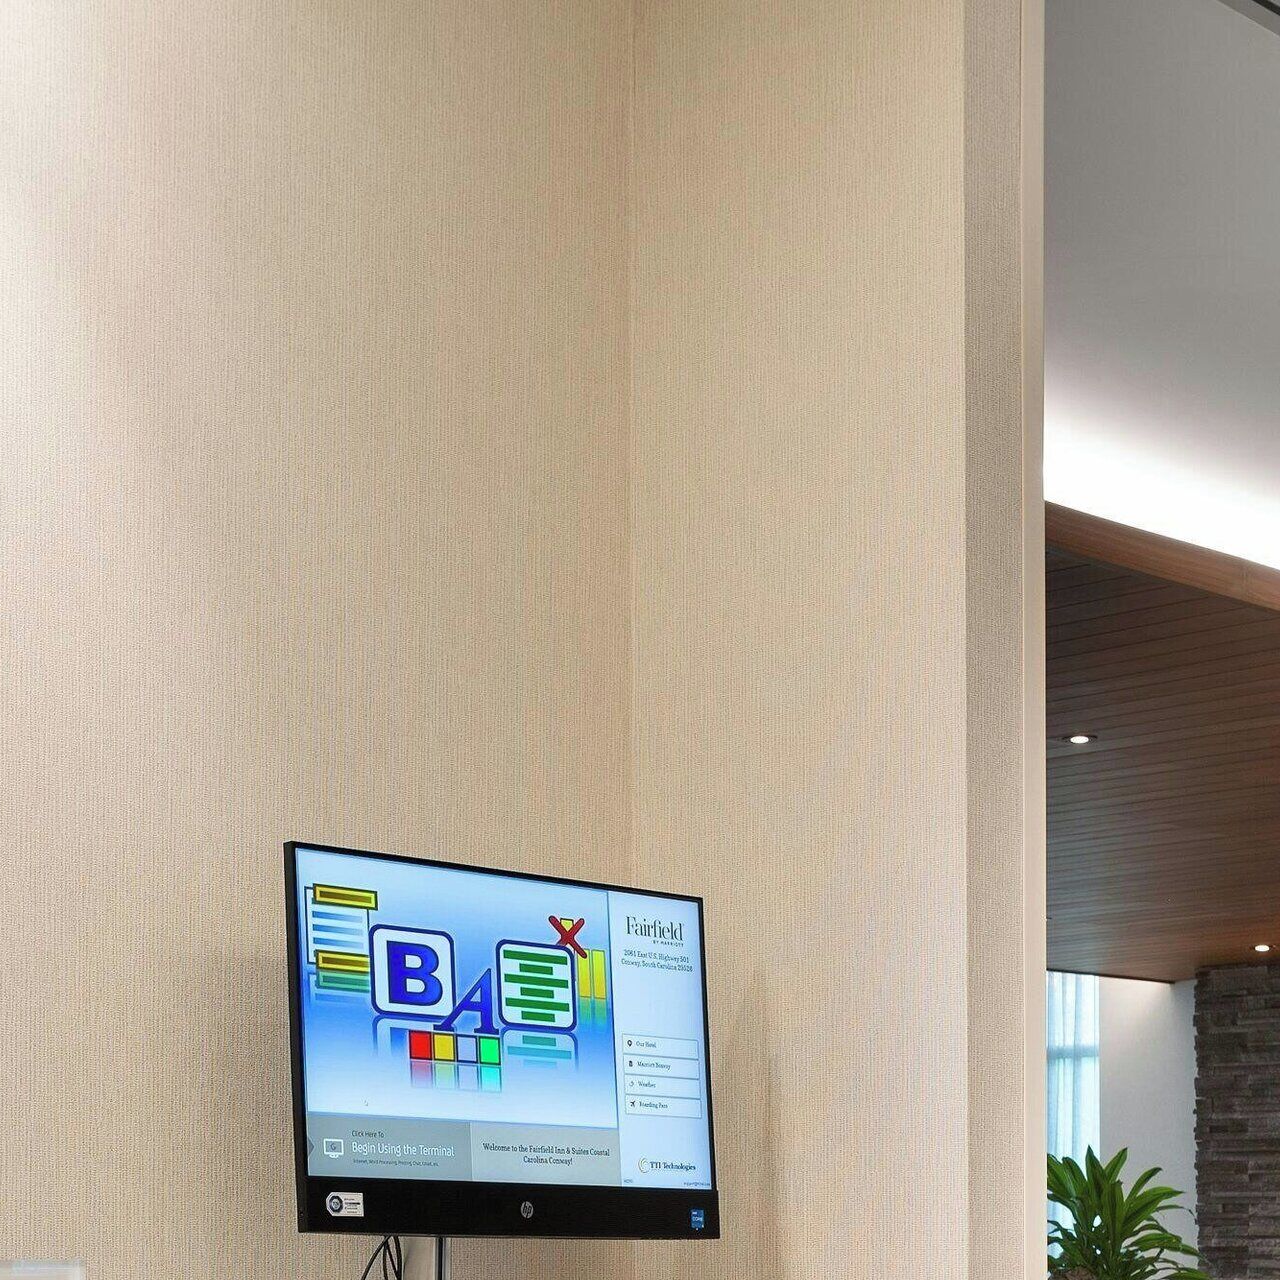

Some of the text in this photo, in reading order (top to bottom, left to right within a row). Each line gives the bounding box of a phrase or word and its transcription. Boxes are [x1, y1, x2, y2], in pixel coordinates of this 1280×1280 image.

[626, 916, 683, 941] Fairfield
[352, 1141, 455, 1157] Begin Using the Terminal
[482, 1143, 511, 1152] Welcome
[511, 1144, 518, 1152] to
[518, 1145, 528, 1153] the
[528, 1145, 554, 1154] Fairfield
[554, 1146, 565, 1154] Inn
[571, 1147, 589, 1156] Suites
[589, 1148, 610, 1157] Coastal
[523, 1155, 573, 1166] Carolina Conway!
[650, 1161, 696, 1171] TTI Technologies
[521, 1201, 534, 1219] hp
